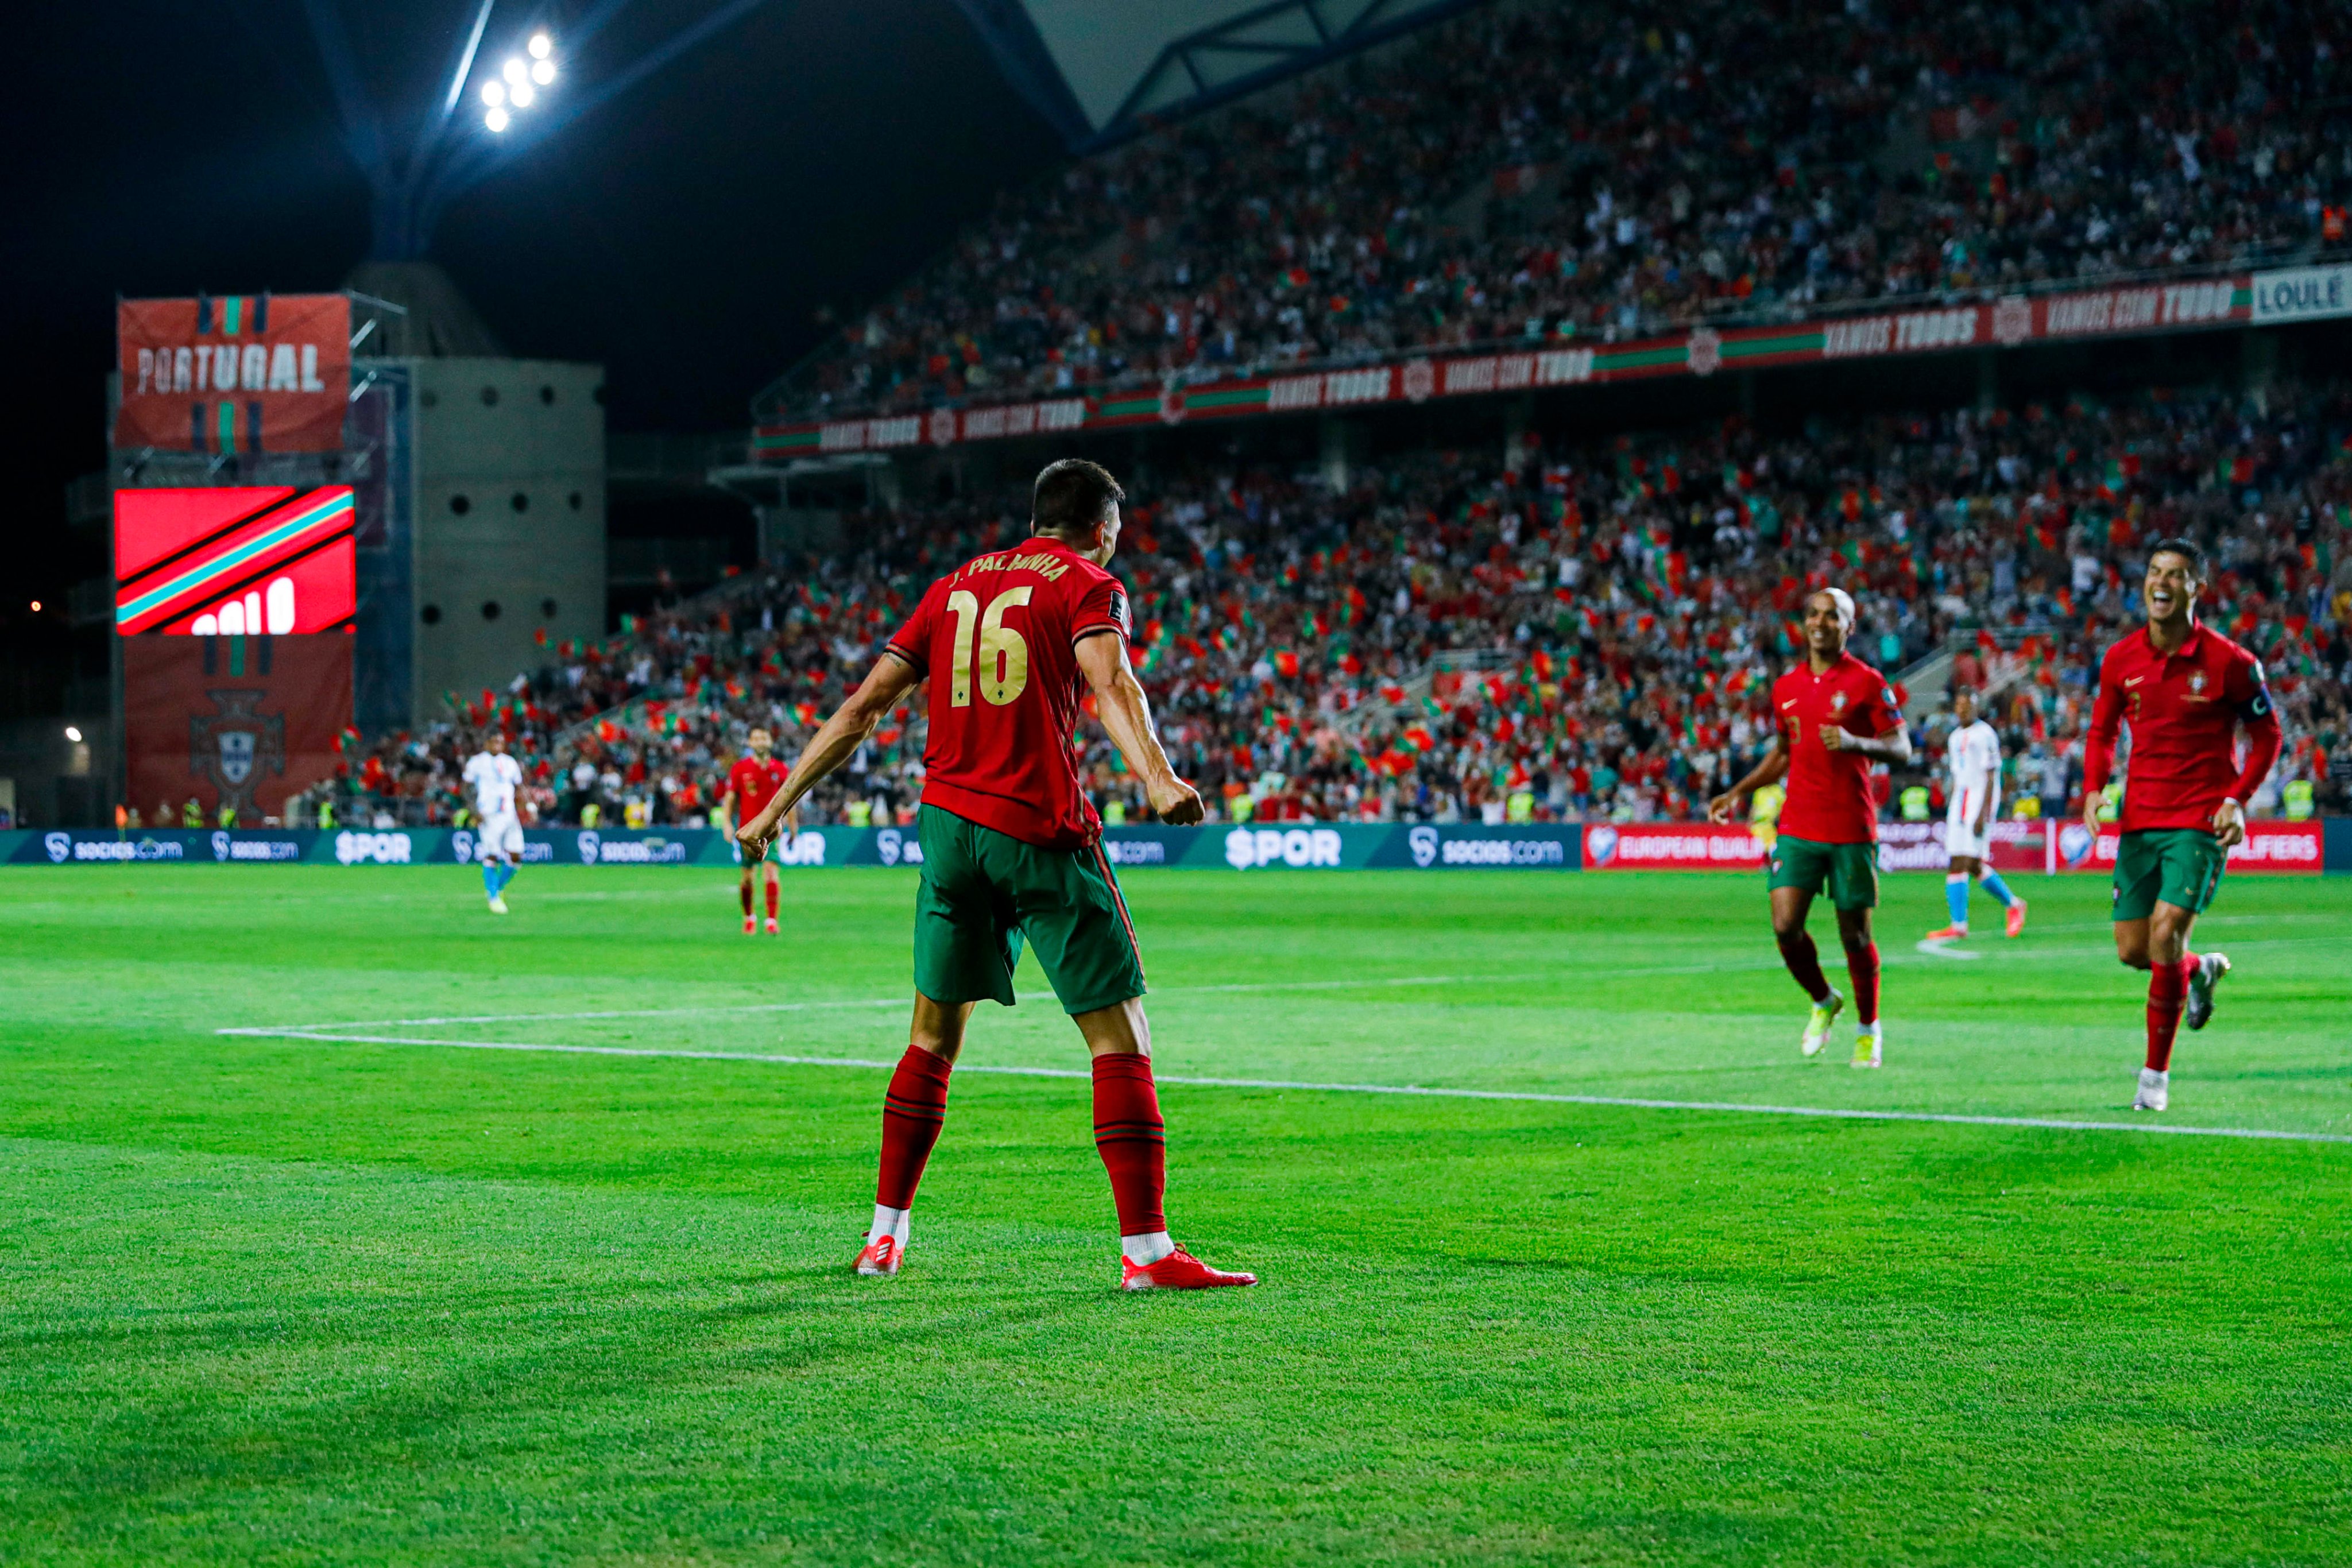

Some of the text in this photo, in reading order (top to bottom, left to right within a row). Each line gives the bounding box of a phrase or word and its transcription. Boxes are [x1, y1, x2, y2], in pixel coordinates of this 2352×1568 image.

[137, 343, 325, 394] PORTUGAL
[949, 553, 1069, 589] J. PALHINHA
[946, 586, 1033, 707] 16
[1225, 826, 1341, 870] $POR
[1619, 836, 1708, 860] EUROPEAN
